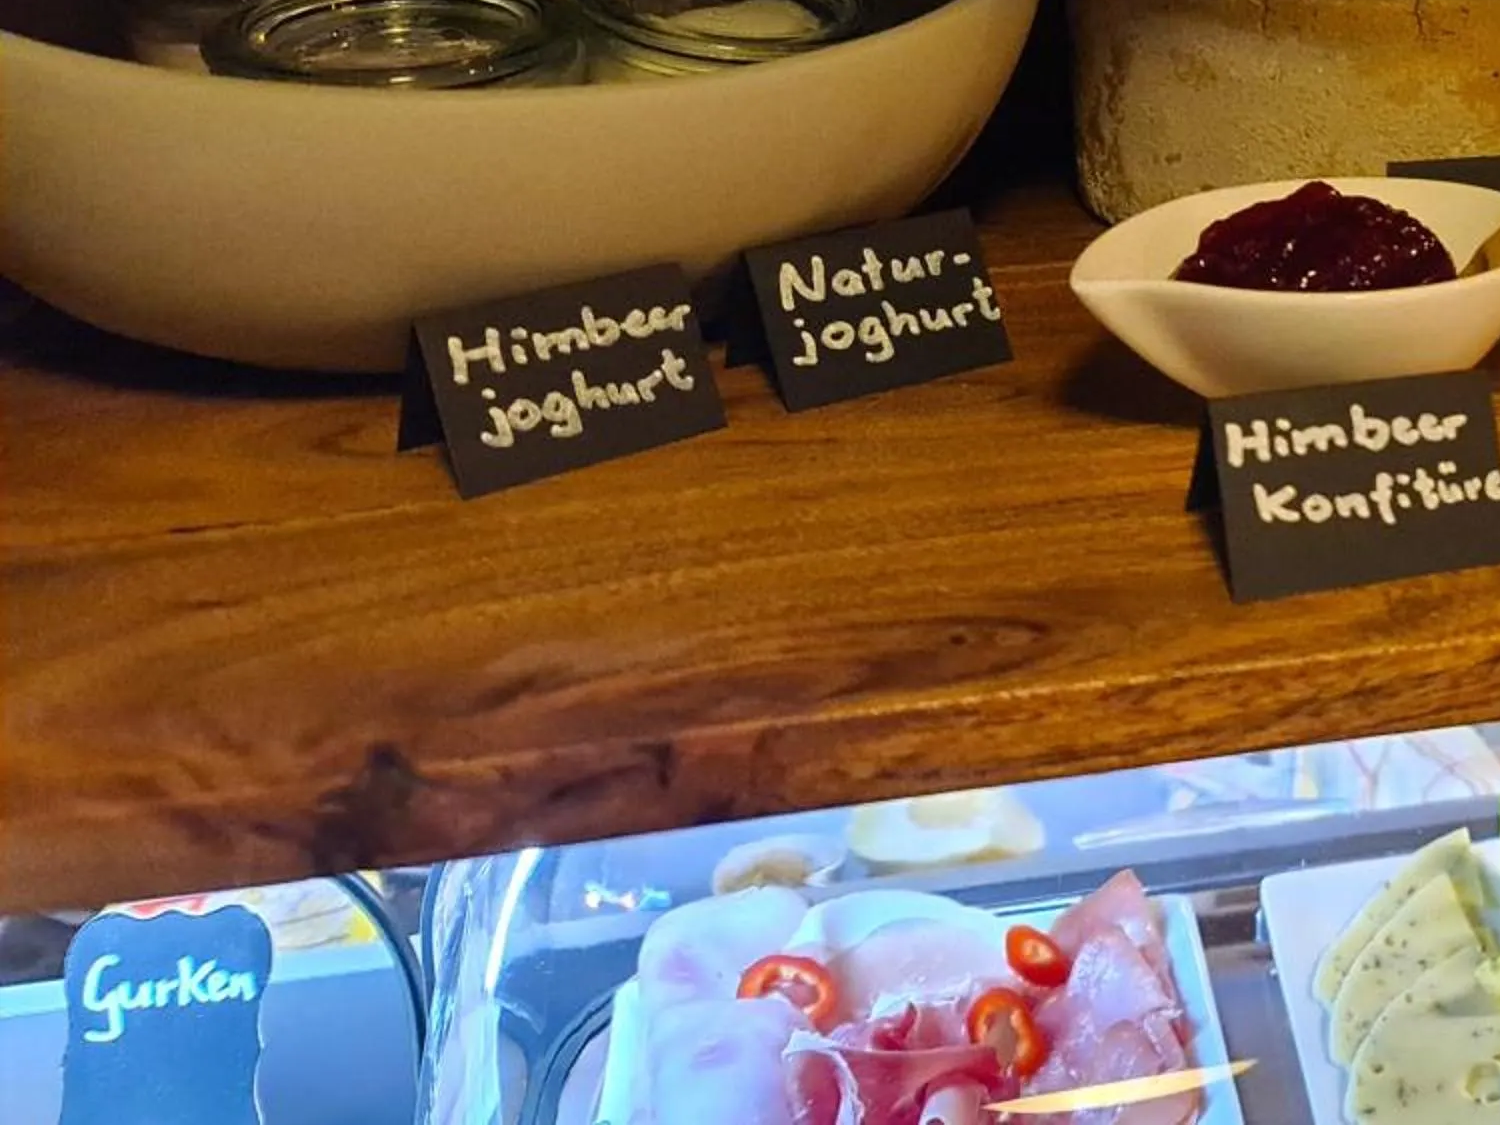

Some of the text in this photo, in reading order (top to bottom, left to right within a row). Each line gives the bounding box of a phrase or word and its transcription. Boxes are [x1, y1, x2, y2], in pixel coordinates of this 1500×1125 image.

[779, 247, 971, 313] Natur-
[448, 305, 692, 385] Himbeer
[793, 277, 1001, 367] joghurt
[480, 348, 695, 448] joghurt
[1224, 403, 1468, 468] Himbeer
